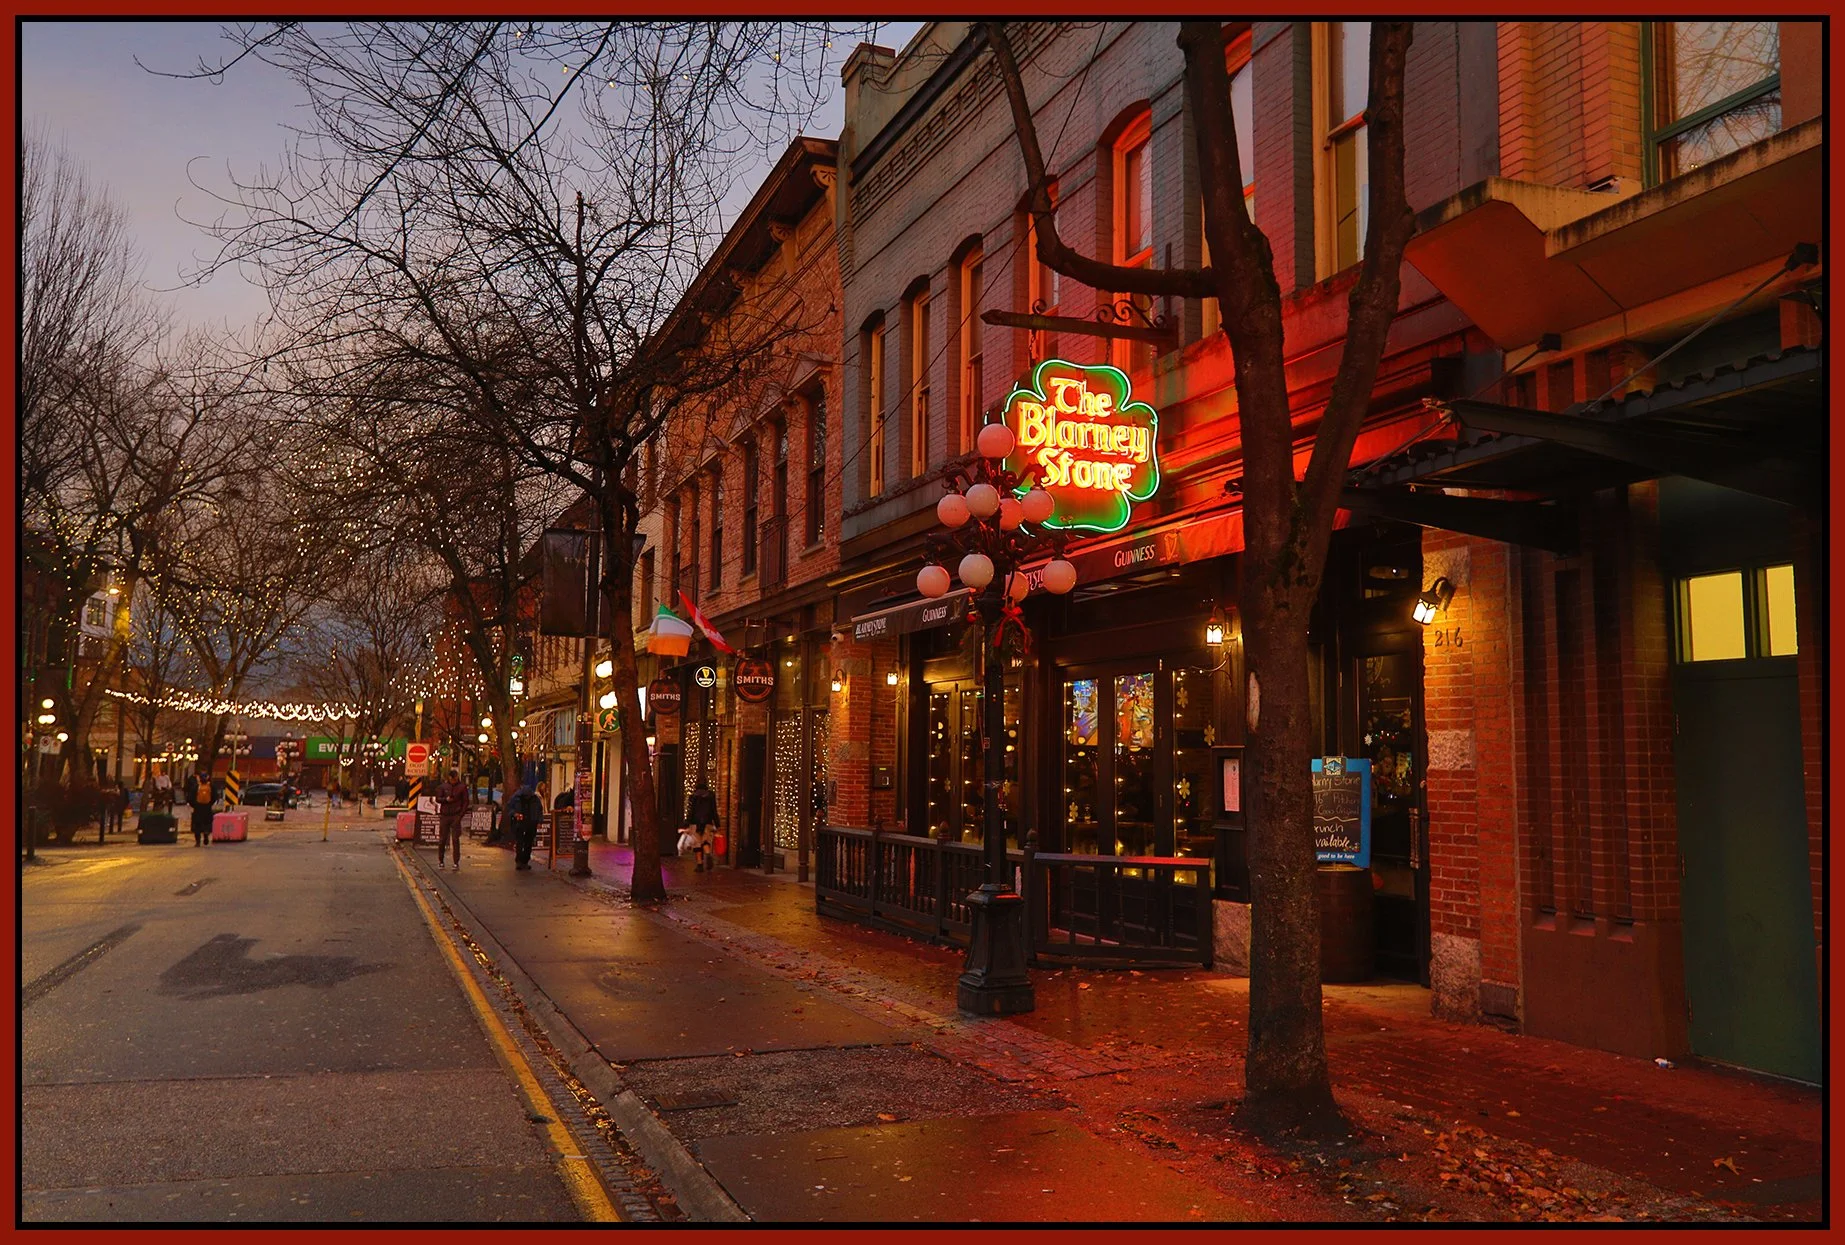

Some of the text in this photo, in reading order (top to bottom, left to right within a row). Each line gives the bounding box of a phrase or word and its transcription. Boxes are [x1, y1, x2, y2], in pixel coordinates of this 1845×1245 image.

[1050, 376, 1113, 418] The
[1017, 401, 1150, 463] Blarney
[1037, 447, 1136, 491] Stone
[1114, 544, 1156, 568] GUINNESS
[922, 605, 948, 623] GUINNESS
[1434, 626, 1464, 648] 216
[736, 675, 774, 686] SMITHS
[650, 693, 681, 702] SMITHS
[1313, 823, 1344, 834] runch
[1315, 833, 1350, 850] vailable
